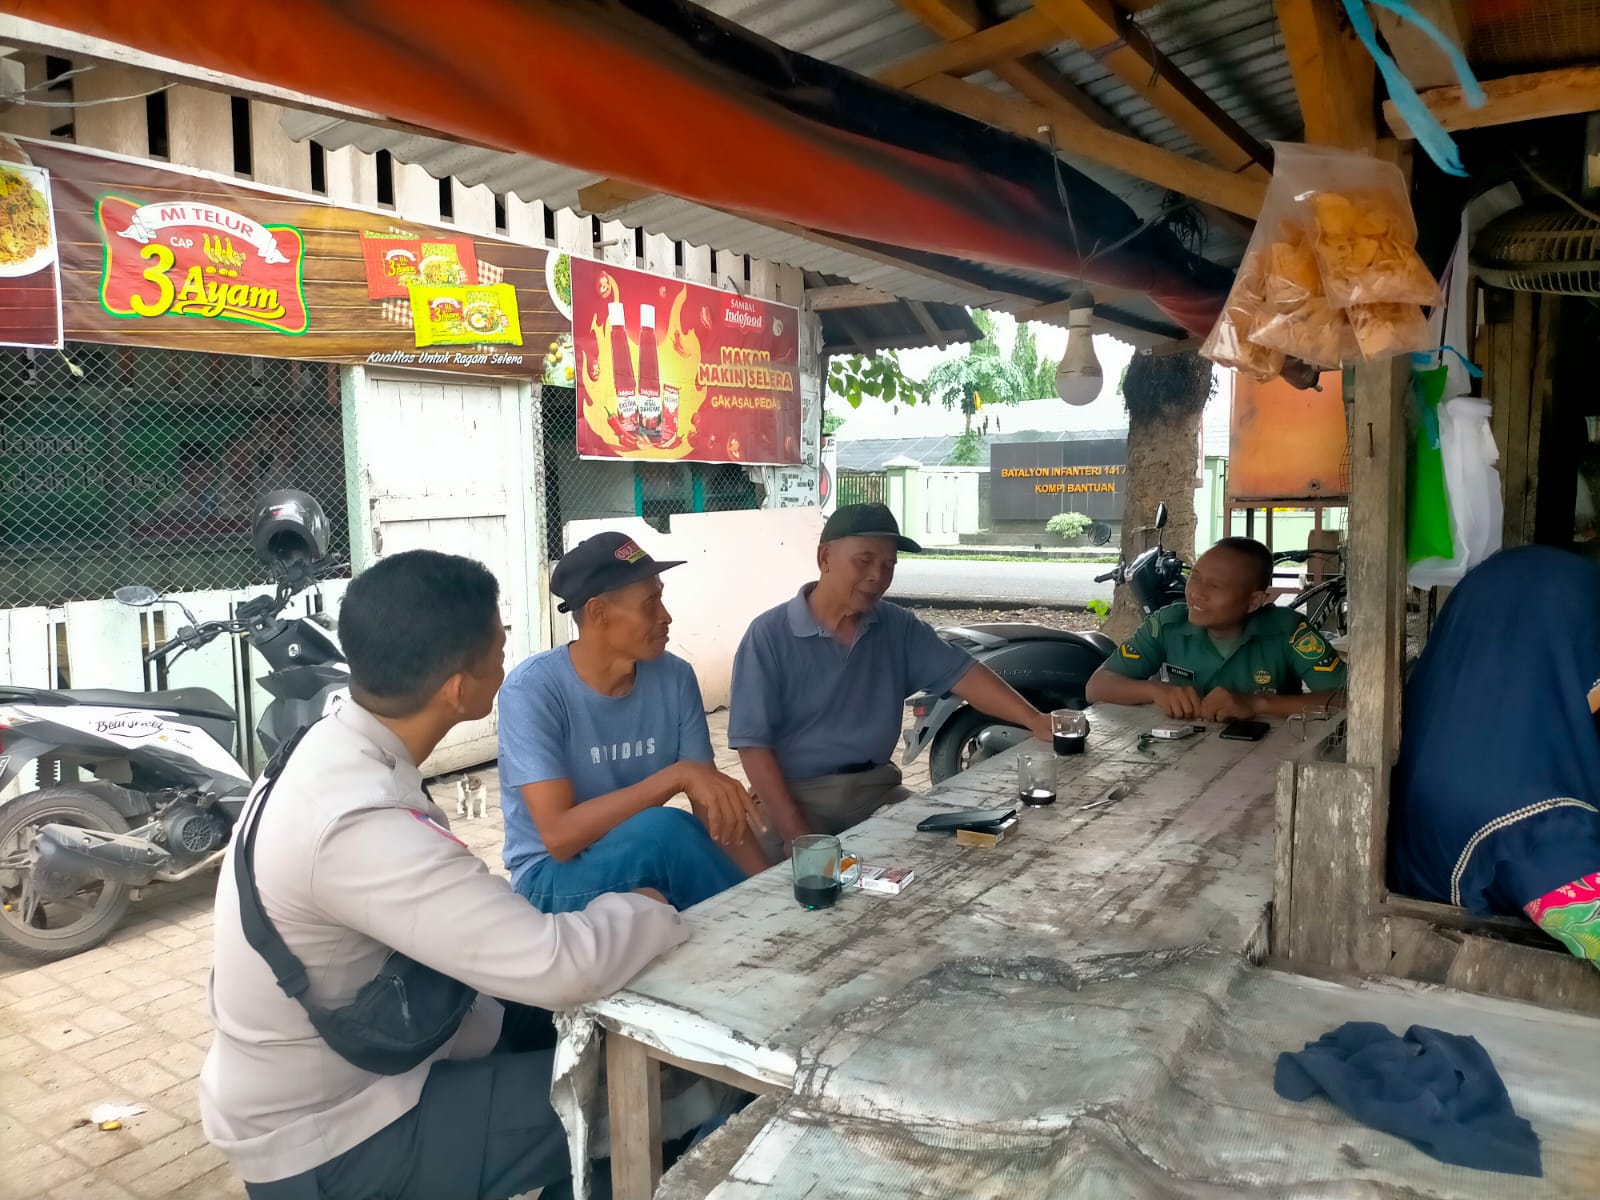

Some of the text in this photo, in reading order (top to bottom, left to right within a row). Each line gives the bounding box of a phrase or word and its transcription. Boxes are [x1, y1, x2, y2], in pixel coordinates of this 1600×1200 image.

[160, 207, 254, 238] MI TELUR
[169, 236, 194, 249] CAP
[130, 243, 286, 320] 3 Ayam
[730, 298, 756, 312] SAMBAL
[725, 309, 763, 329] Indofood
[366, 350, 523, 368] Kualitas Untuk Ragam Selera
[721, 346, 771, 368] MAKAN
[698, 362, 794, 392] MAKIN SELERA
[711, 394, 731, 408] GAK
[731, 395, 754, 409] ASAL
[1001, 466, 1049, 478] BATALYON
[1051, 465, 1102, 477] INFANTERI
[1035, 483, 1116, 494] KOMPI BANTUAN
